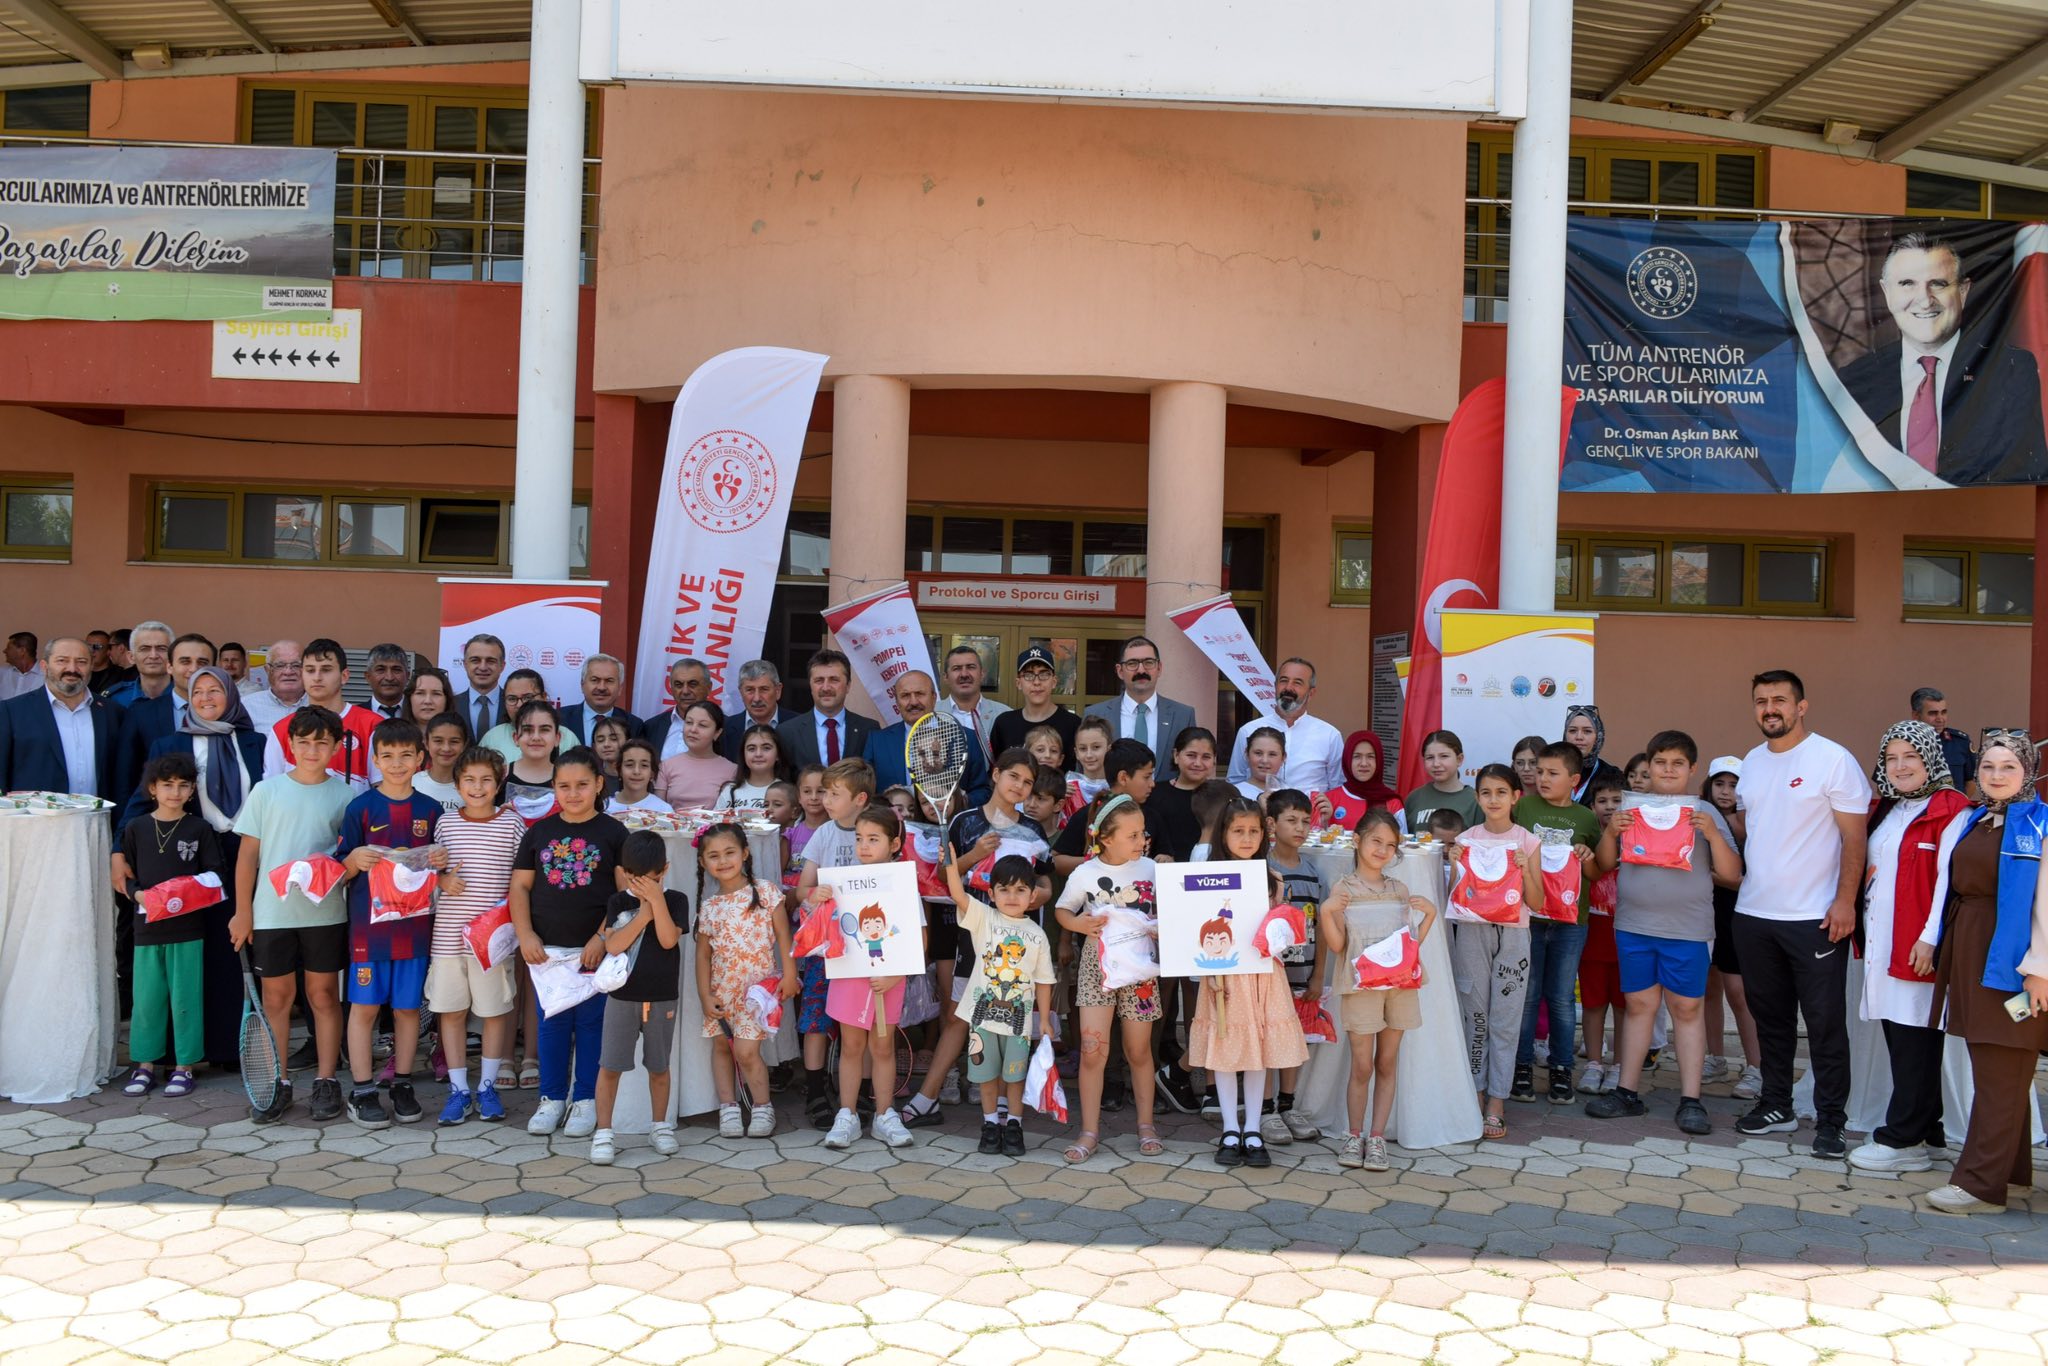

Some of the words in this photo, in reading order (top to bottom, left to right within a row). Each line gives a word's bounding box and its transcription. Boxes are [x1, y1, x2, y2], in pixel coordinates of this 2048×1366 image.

[117, 186, 139, 205] ve
[141, 182, 307, 207] ANTRENÖRLERİMİZE
[136, 230, 247, 267] Dilerim
[268, 289, 294, 298] MEHMET
[296, 289, 327, 298] KORKMAZ
[1587, 341, 1634, 363] TÜM
[1638, 344, 1745, 365] ANTRENÖR
[1566, 364, 1592, 382] VE
[1597, 365, 1769, 385] SPORCULARIMIZA
[1576, 387, 1668, 406] BAŞARILAR
[1671, 387, 1765, 405] DİLİYORUM
[1604, 427, 1623, 440] Dr.
[1625, 428, 1668, 441] Osman
[1671, 428, 1709, 442] Aşkın
[1712, 429, 1739, 441] BAK
[1585, 444, 1644, 462] GENÇLİK
[1647, 446, 1663, 459] VE
[1666, 446, 1702, 459] SPOR
[1705, 446, 1759, 459] BAKANI
[676, 573, 706, 615] VE
[929, 586, 987, 599] Protokol
[991, 590, 1007, 599] ve
[1010, 588, 1060, 602] Sporcu
[1063, 590, 1100, 604] Girişi
[847, 876, 878, 890] TENİS
[1196, 876, 1230, 887] YÜZME
[1498, 964, 1521, 978] DIOR
